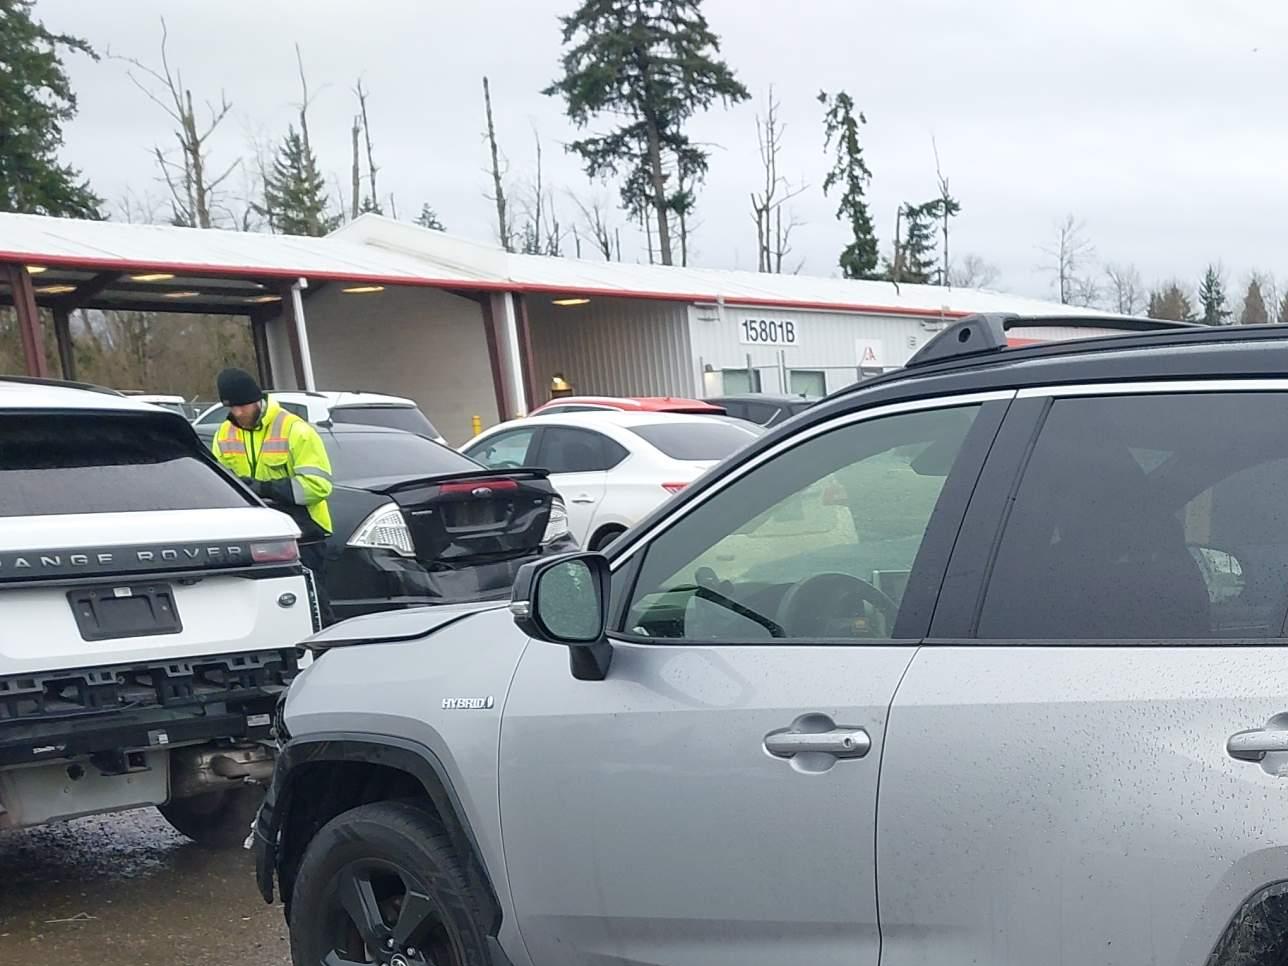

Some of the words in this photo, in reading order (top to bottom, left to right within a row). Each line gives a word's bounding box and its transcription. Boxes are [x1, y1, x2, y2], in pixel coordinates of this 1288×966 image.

[741, 319, 795, 343] 15801B
[0, 553, 113, 568] ANGE
[136, 546, 242, 561] ROVER
[441, 697, 487, 710] HYBRID
